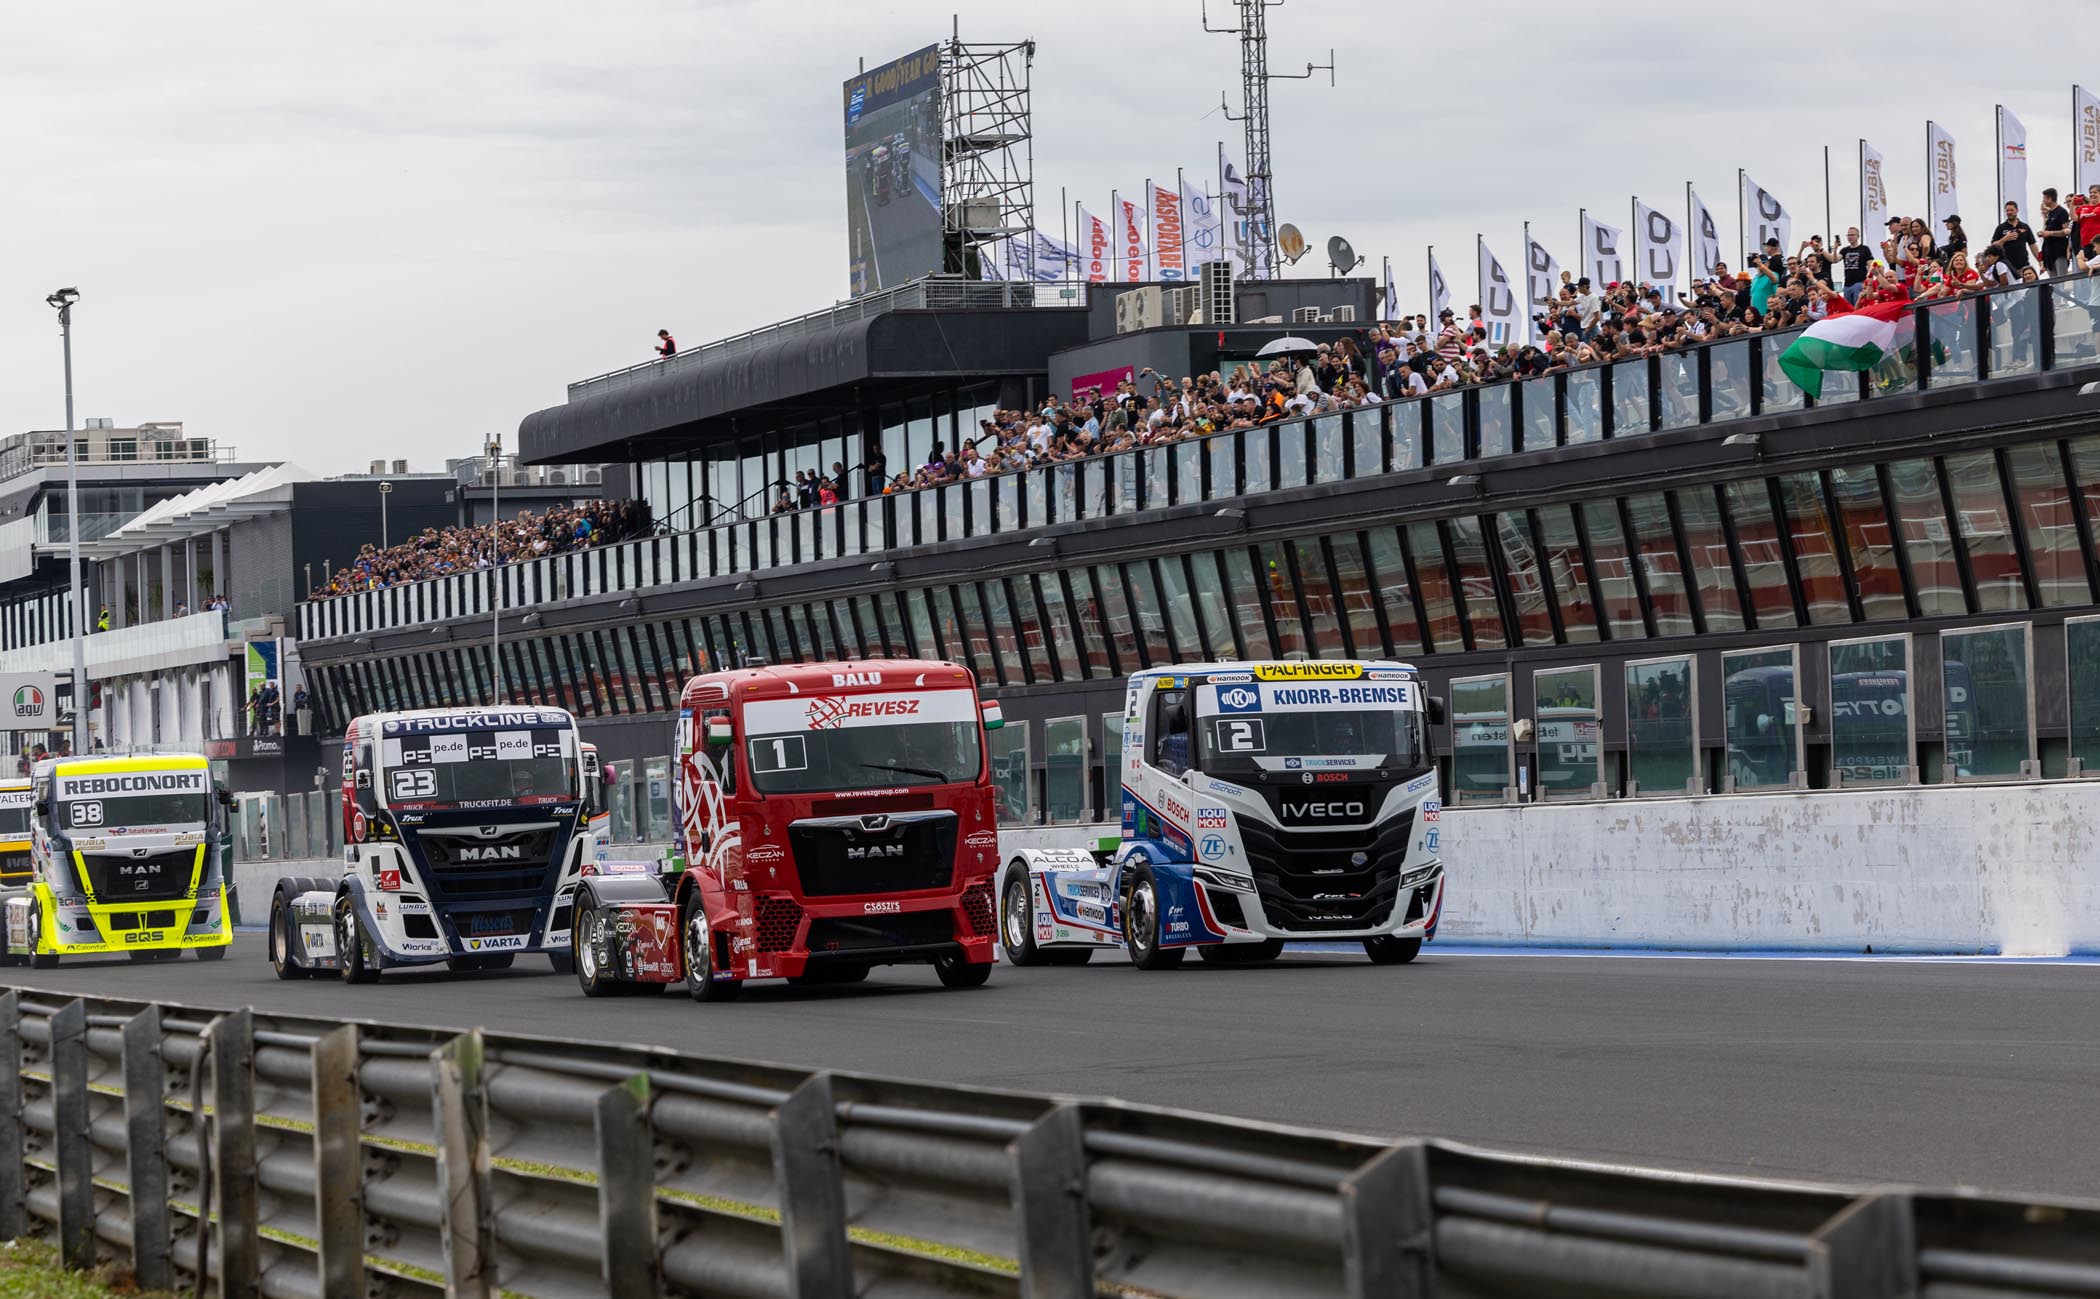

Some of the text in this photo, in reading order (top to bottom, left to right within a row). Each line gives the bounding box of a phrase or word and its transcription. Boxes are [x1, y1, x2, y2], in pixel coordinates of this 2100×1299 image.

[1261, 664, 1357, 677] PALFINGER
[832, 672, 882, 688] BALU
[1273, 687, 1408, 705] KNORR-BREMSE
[401, 713, 538, 731] TRUCKLINE
[1230, 723, 1254, 750] 2
[434, 743, 463, 753] pe.de
[499, 739, 528, 749] pe.de
[772, 739, 787, 769] 1
[396, 770, 435, 797] 23
[1316, 773, 1349, 782] BOSCH
[64, 774, 202, 796] REBOCONORT
[834, 787, 909, 799] www.reveszgroup.com
[459, 798, 513, 809] TRUCKFIT.DE
[1282, 801, 1364, 818] IVECO
[1424, 802, 1440, 811] LIQU
[73, 803, 102, 823] 38
[1167, 798, 1189, 823] BOSCH
[1198, 809, 1226, 818] LIQUI
[1424, 812, 1440, 820] MOL
[1198, 818, 1226, 828] MOLY
[459, 845, 520, 861] MAN
[847, 844, 904, 859] MAN
[119, 865, 162, 875] MAN
[1170, 921, 1190, 932] TURBO
[484, 937, 522, 948] VARTA
